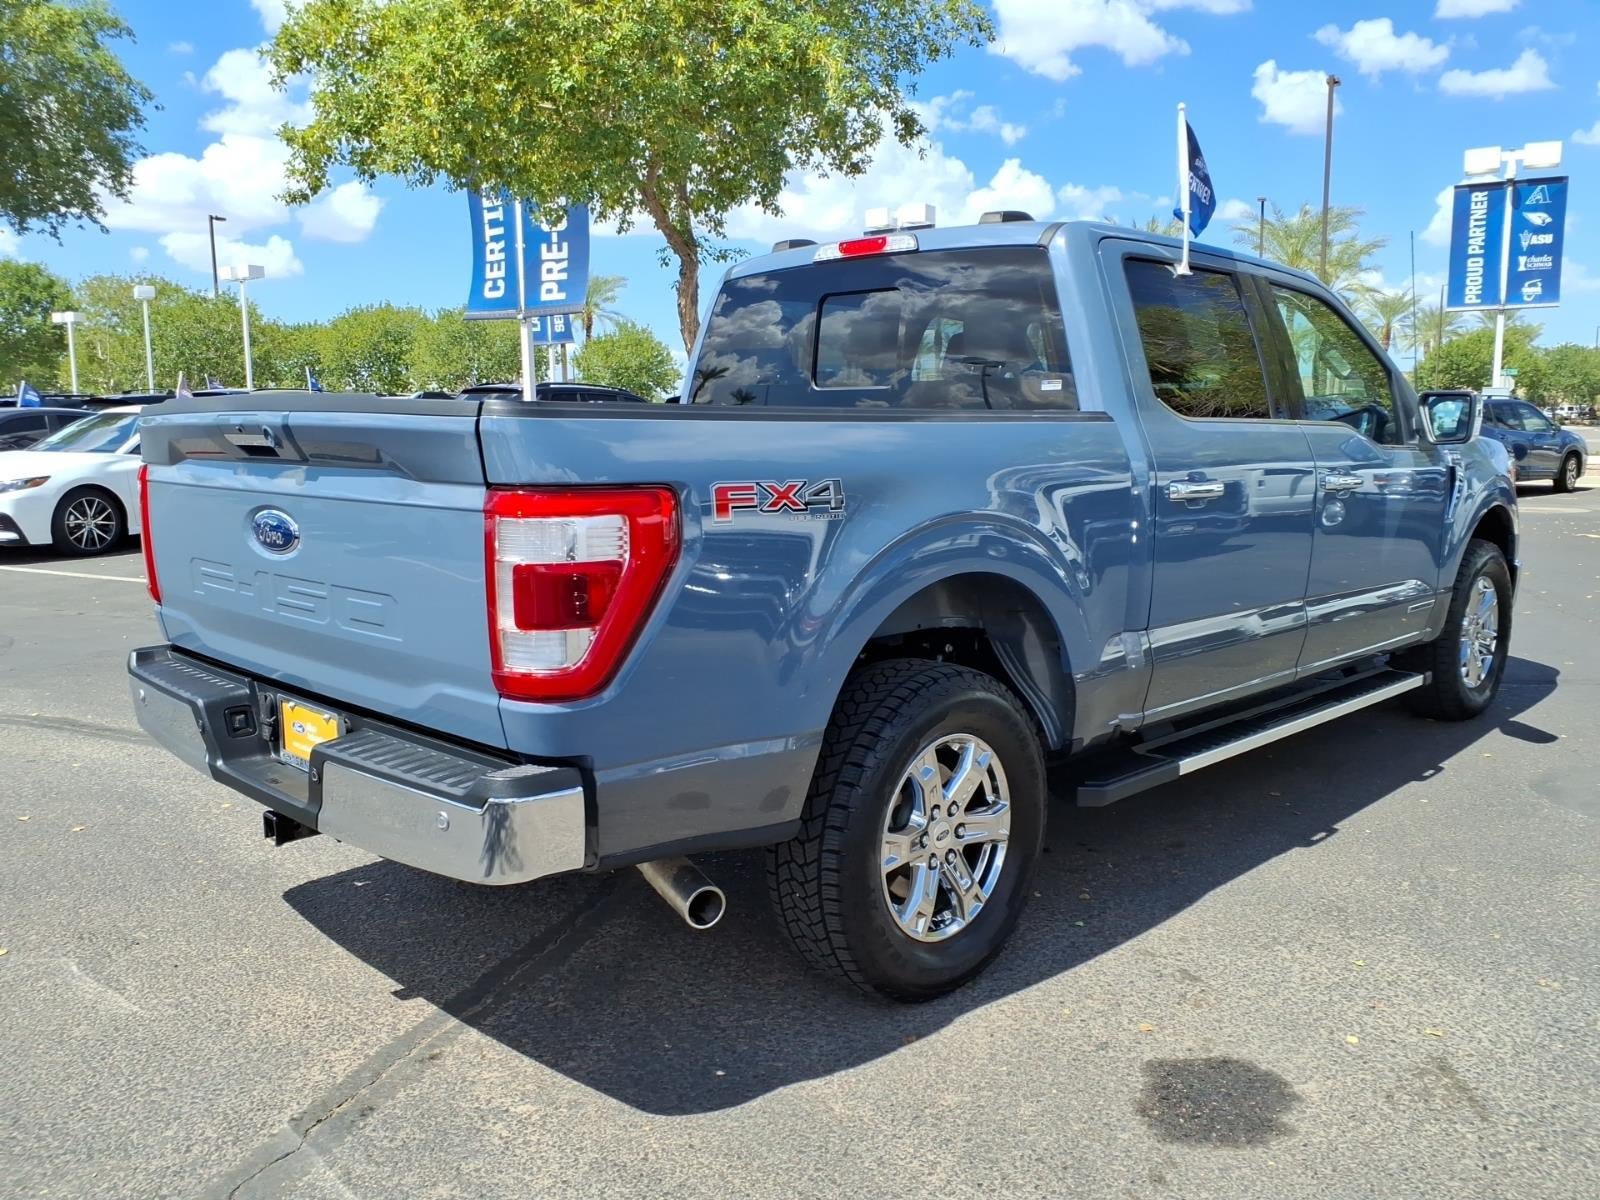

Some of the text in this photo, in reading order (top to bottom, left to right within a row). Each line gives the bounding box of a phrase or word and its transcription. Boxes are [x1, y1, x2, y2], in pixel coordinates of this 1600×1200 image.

[1464, 190, 1489, 305] PROUD PARTNER
[1530, 233, 1554, 246] ASU
[710, 478, 846, 526] FX4
[191, 557, 404, 642] F-150
